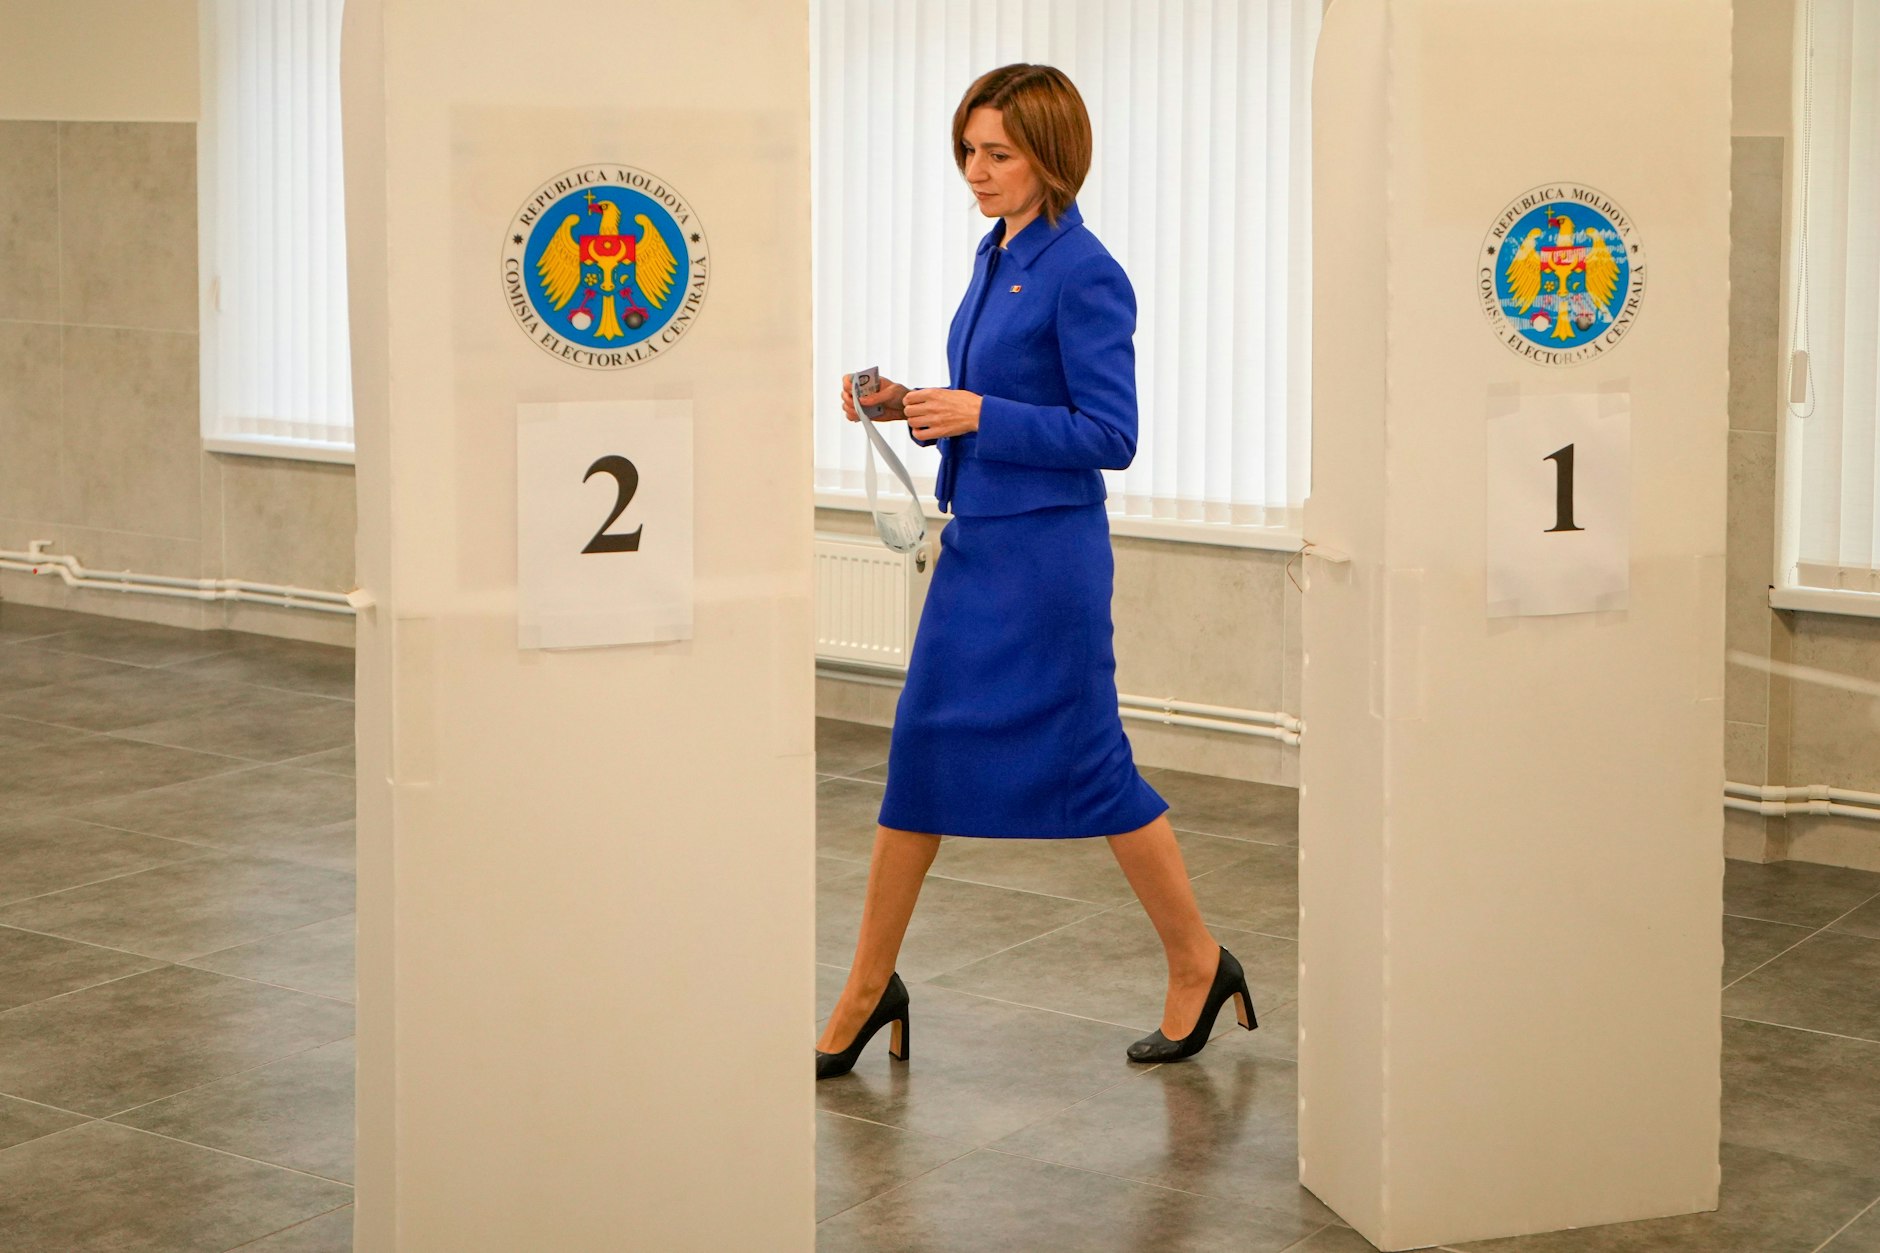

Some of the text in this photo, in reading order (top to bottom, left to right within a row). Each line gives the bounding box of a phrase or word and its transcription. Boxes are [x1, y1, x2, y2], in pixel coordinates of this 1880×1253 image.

[520, 170, 690, 227] REPUBLICA MOLDOVA
[1493, 188, 1631, 239] REPUBLICA MOLDOVA
[505, 256, 706, 367] COMISIA ELECTORALĂ CENTRALĂ
[581, 455, 643, 554] 2
[1543, 443, 1585, 532] 1
